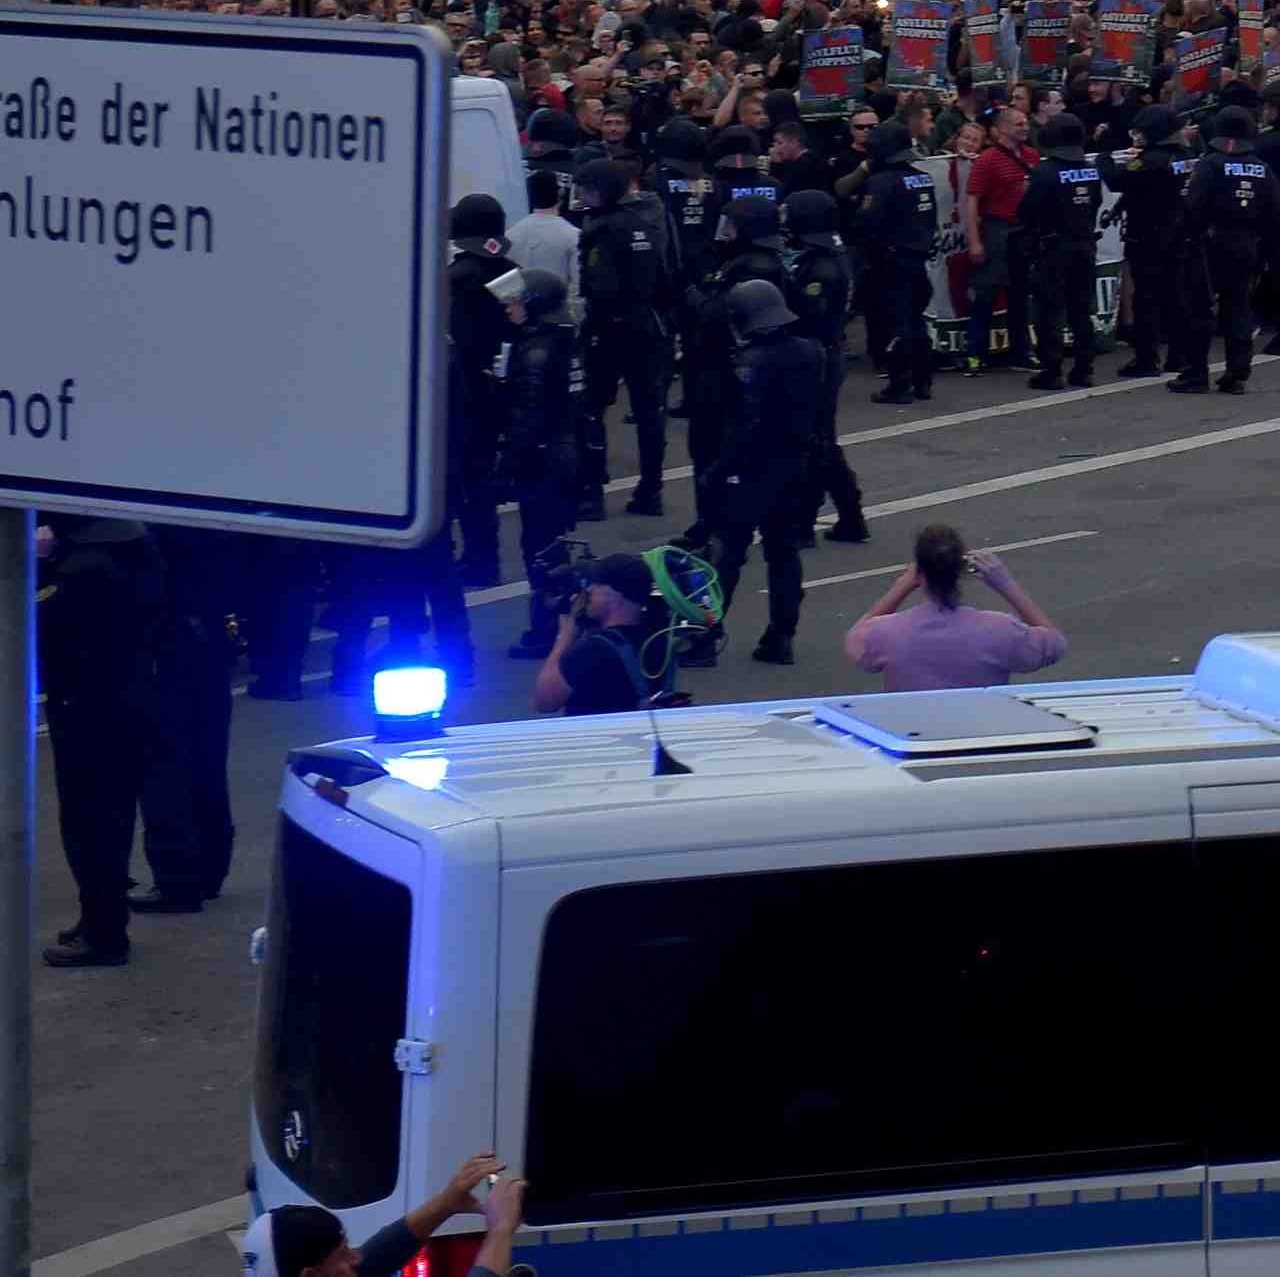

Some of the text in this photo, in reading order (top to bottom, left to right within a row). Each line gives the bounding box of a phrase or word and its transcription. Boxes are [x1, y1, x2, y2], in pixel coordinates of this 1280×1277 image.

[0, 77, 386, 163] aße der Nationen
[1224, 162, 1266, 179] POLIZEI
